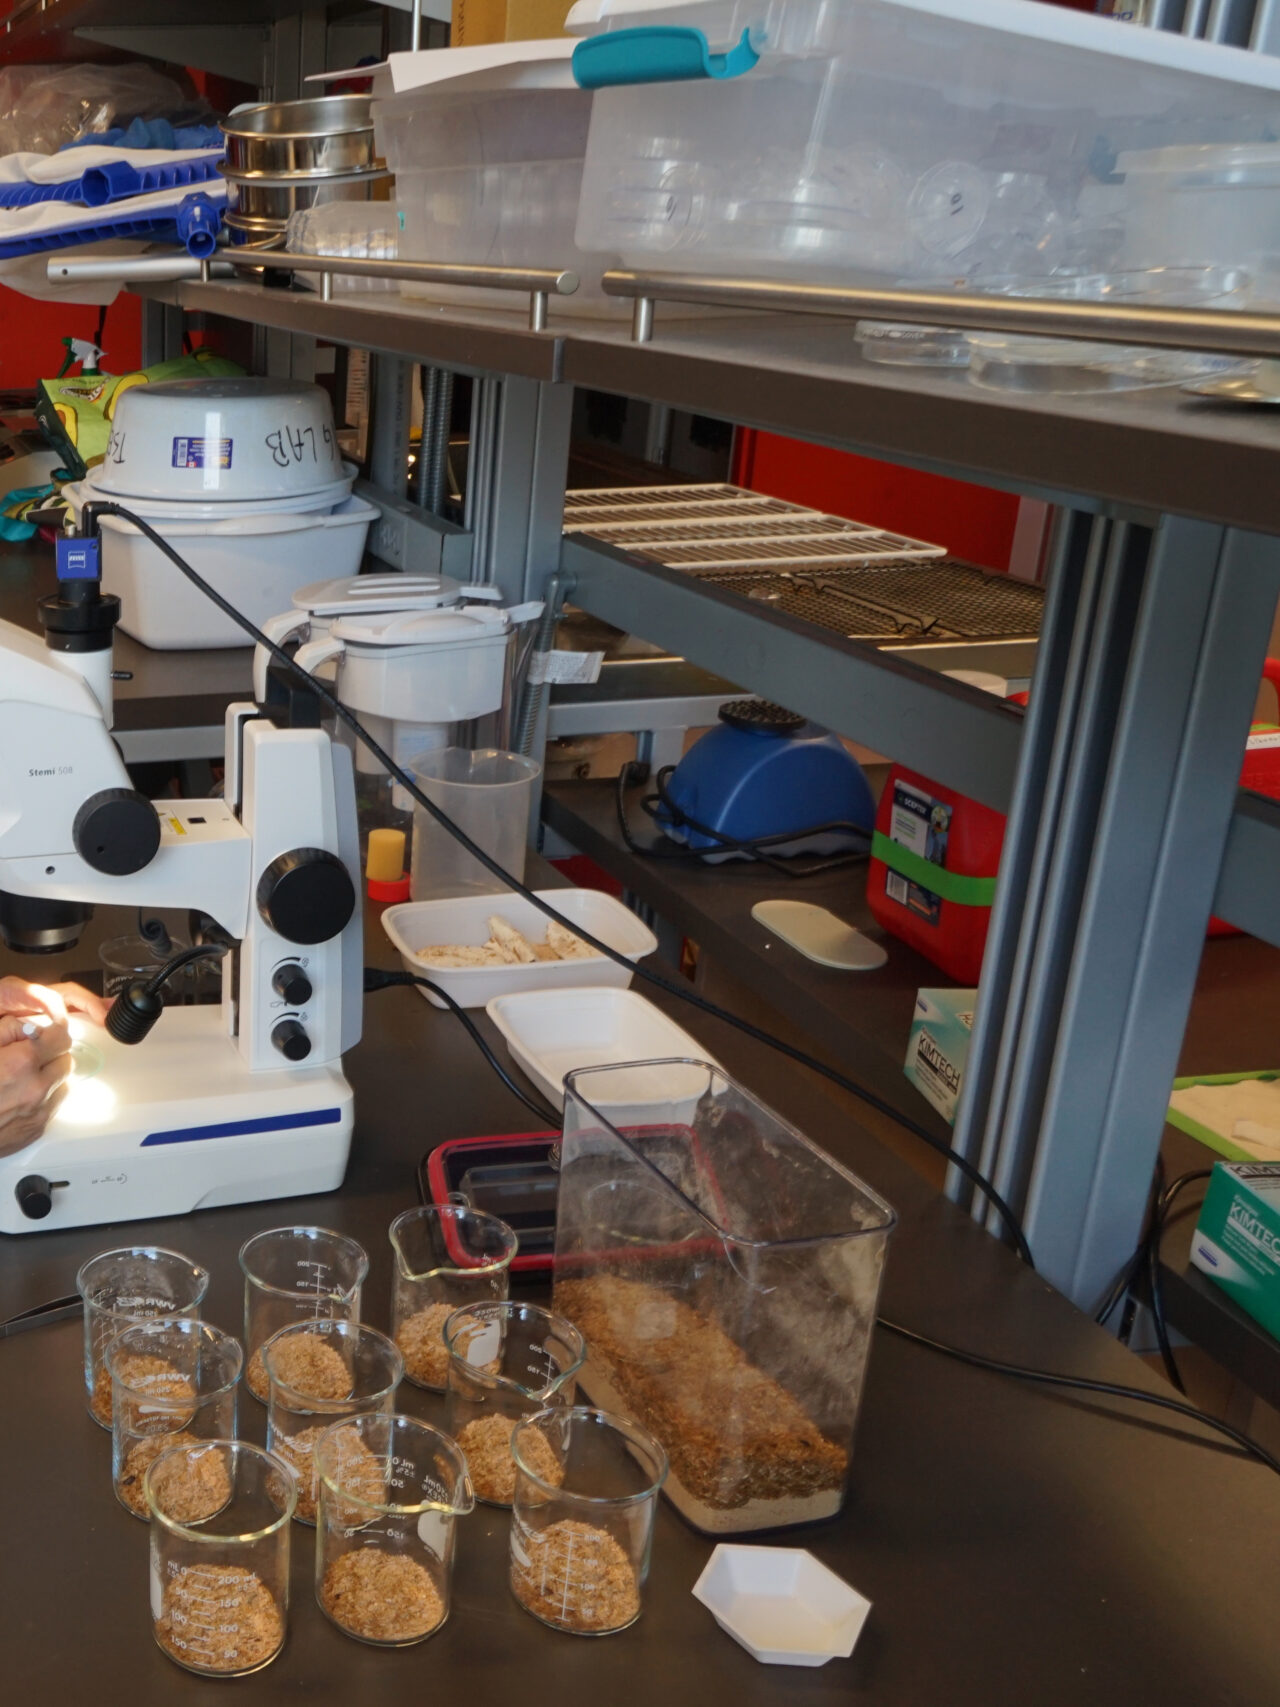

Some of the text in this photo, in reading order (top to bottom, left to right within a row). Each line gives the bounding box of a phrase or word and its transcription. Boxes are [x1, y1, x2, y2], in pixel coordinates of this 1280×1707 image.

[266, 425, 317, 467] LAB
[28, 768, 56, 777] Stemi
[918, 1034, 961, 1088] KIMTECH
[218, 1575, 240, 1585] 200
[219, 1599, 239, 1608] 150
[219, 1624, 238, 1633] 100
